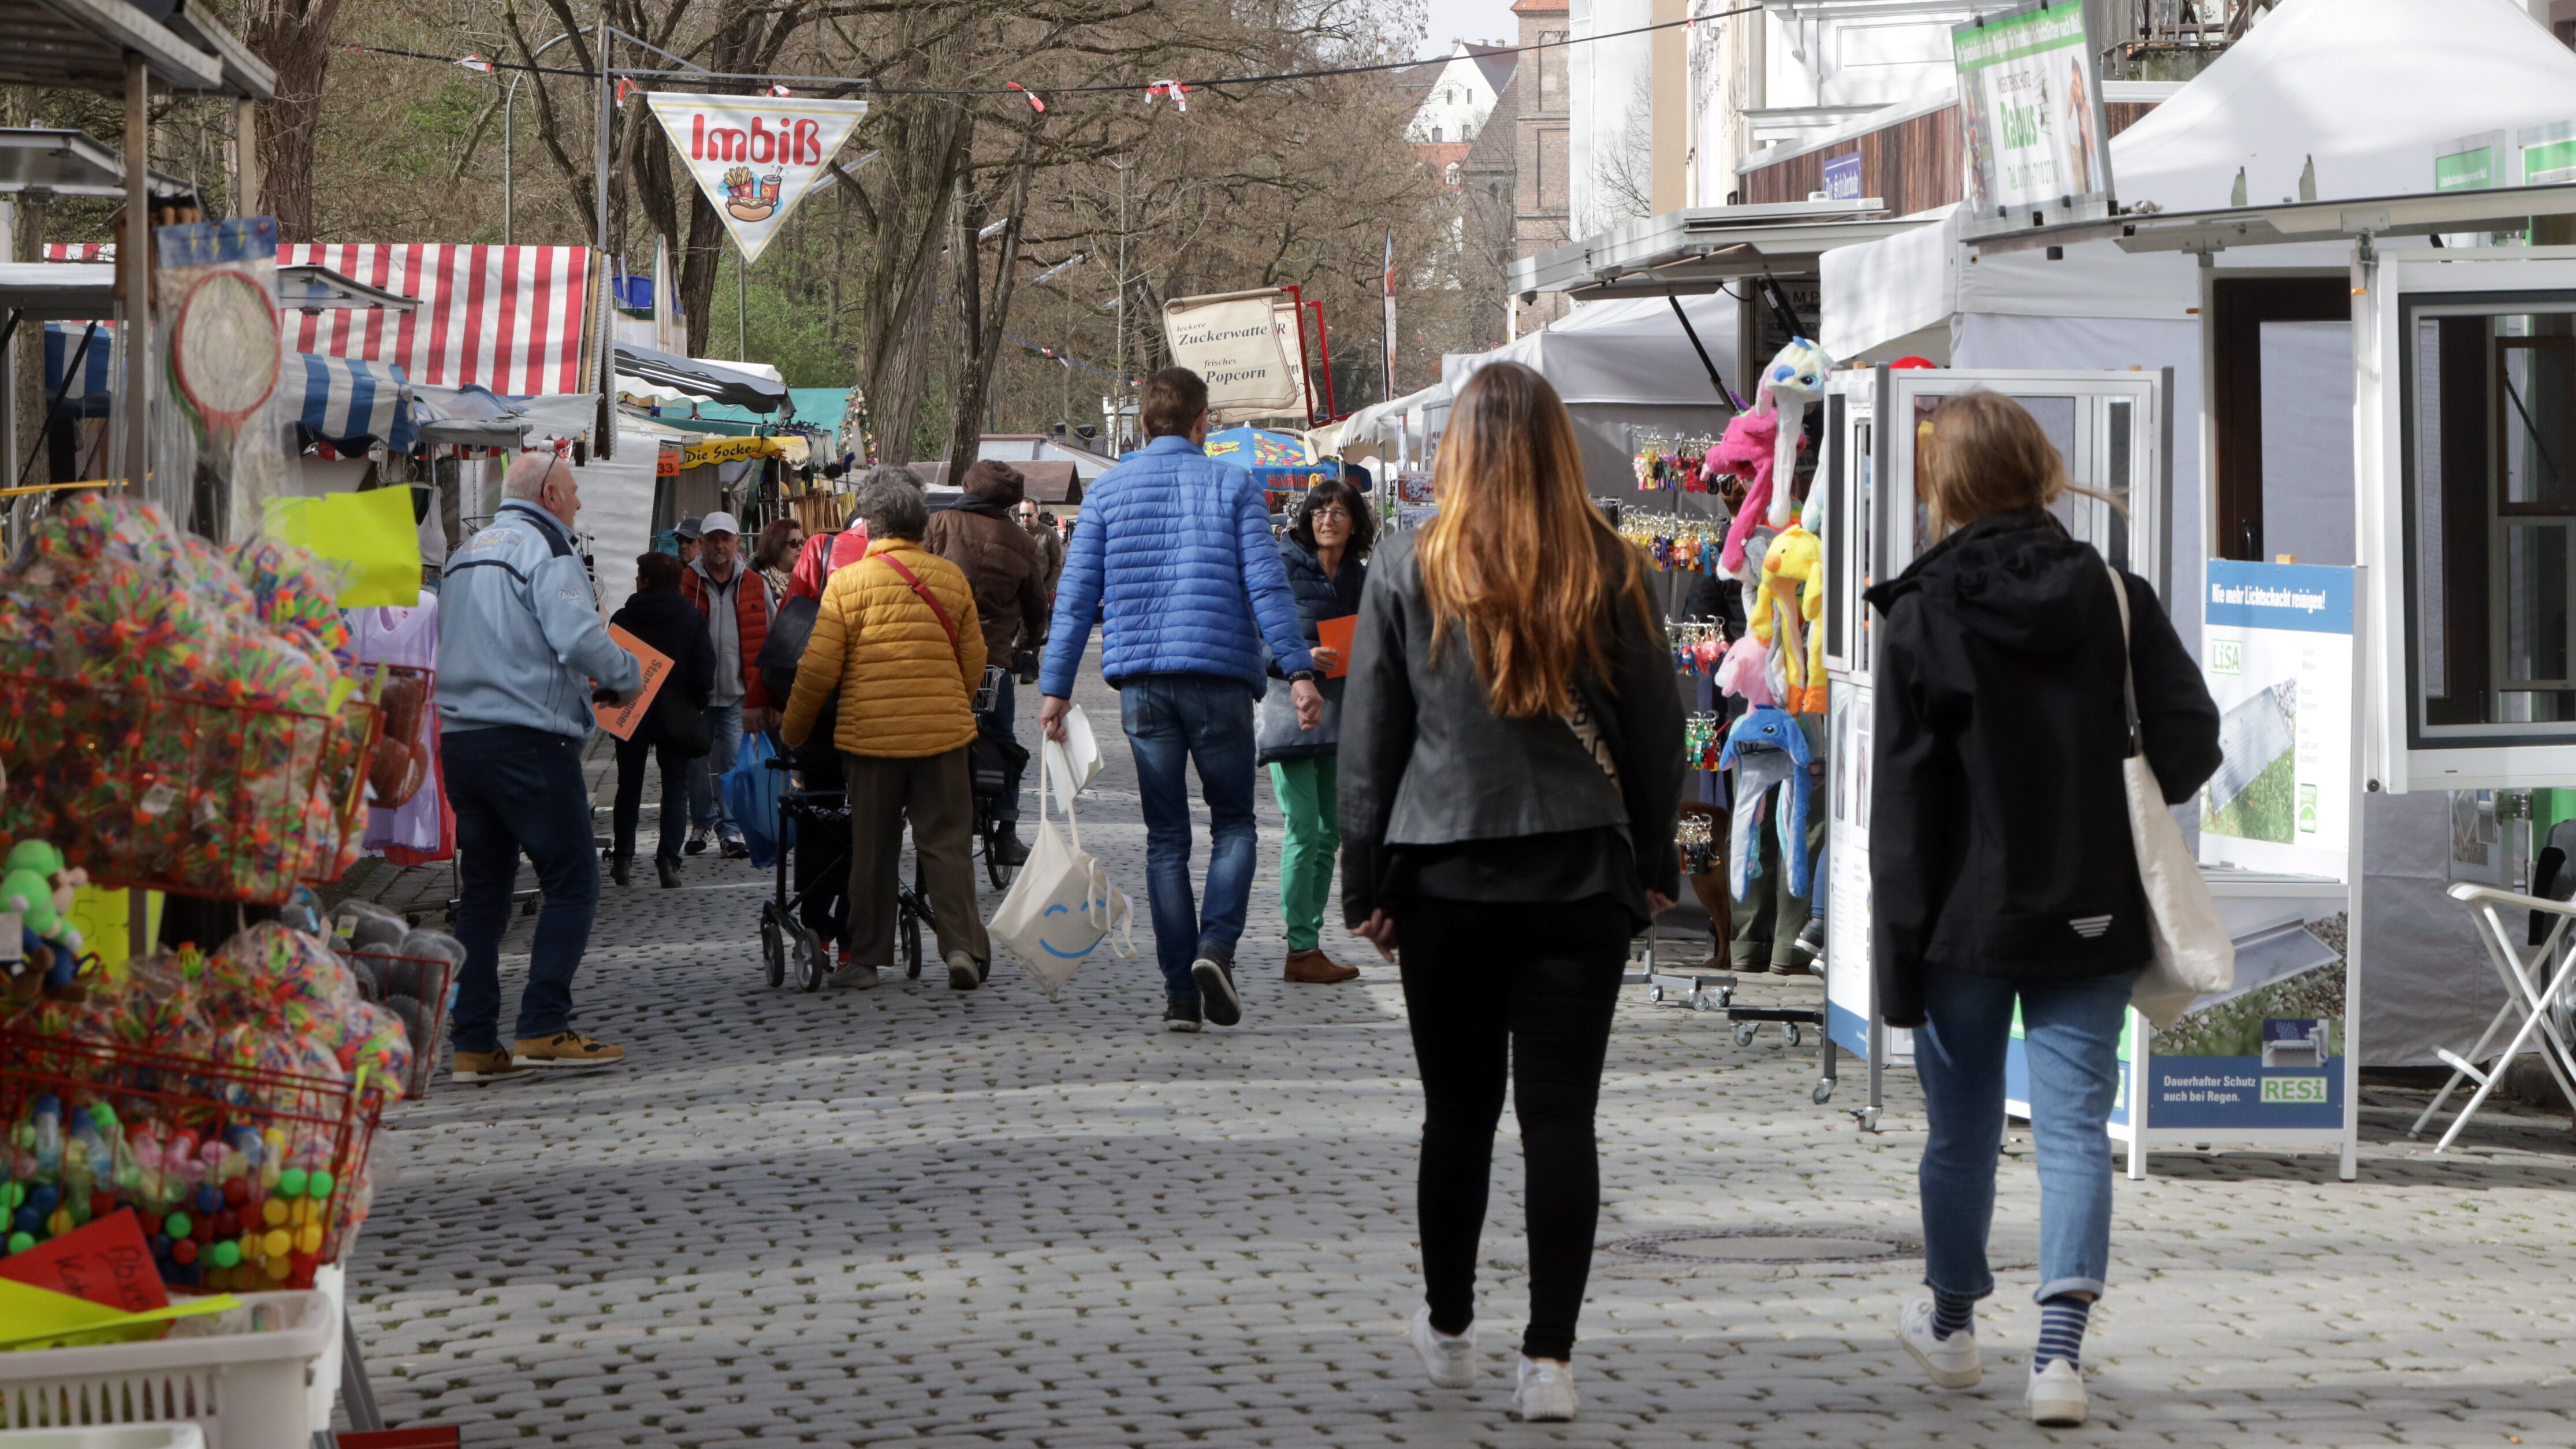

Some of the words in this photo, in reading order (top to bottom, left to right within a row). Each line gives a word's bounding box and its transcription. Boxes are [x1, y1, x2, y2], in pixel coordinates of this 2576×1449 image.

[2000, 97, 2037, 150] Rabus
[691, 114, 821, 166] Imbiß
[1177, 322, 1207, 332] leckere
[1178, 326, 1268, 346] Zuckerwatte
[1203, 358, 1237, 369] frisches
[1206, 368, 1265, 385] Popcorn
[685, 450, 708, 462] Die
[713, 443, 751, 460] Socke
[2212, 583, 2225, 603] Nie
[2225, 585, 2244, 604] mehr
[2244, 585, 2291, 608] Lichtschacht
[2291, 588, 2325, 614] reinigen!
[2164, 1076, 2221, 1087] Dauerhafter
[2224, 1076, 2256, 1087] Schutz
[2265, 1079, 2324, 1099] RESi
[2164, 1091, 2187, 1102] auch
[2190, 1091, 2205, 1102] bei
[2208, 1091, 2240, 1104] Regen.
